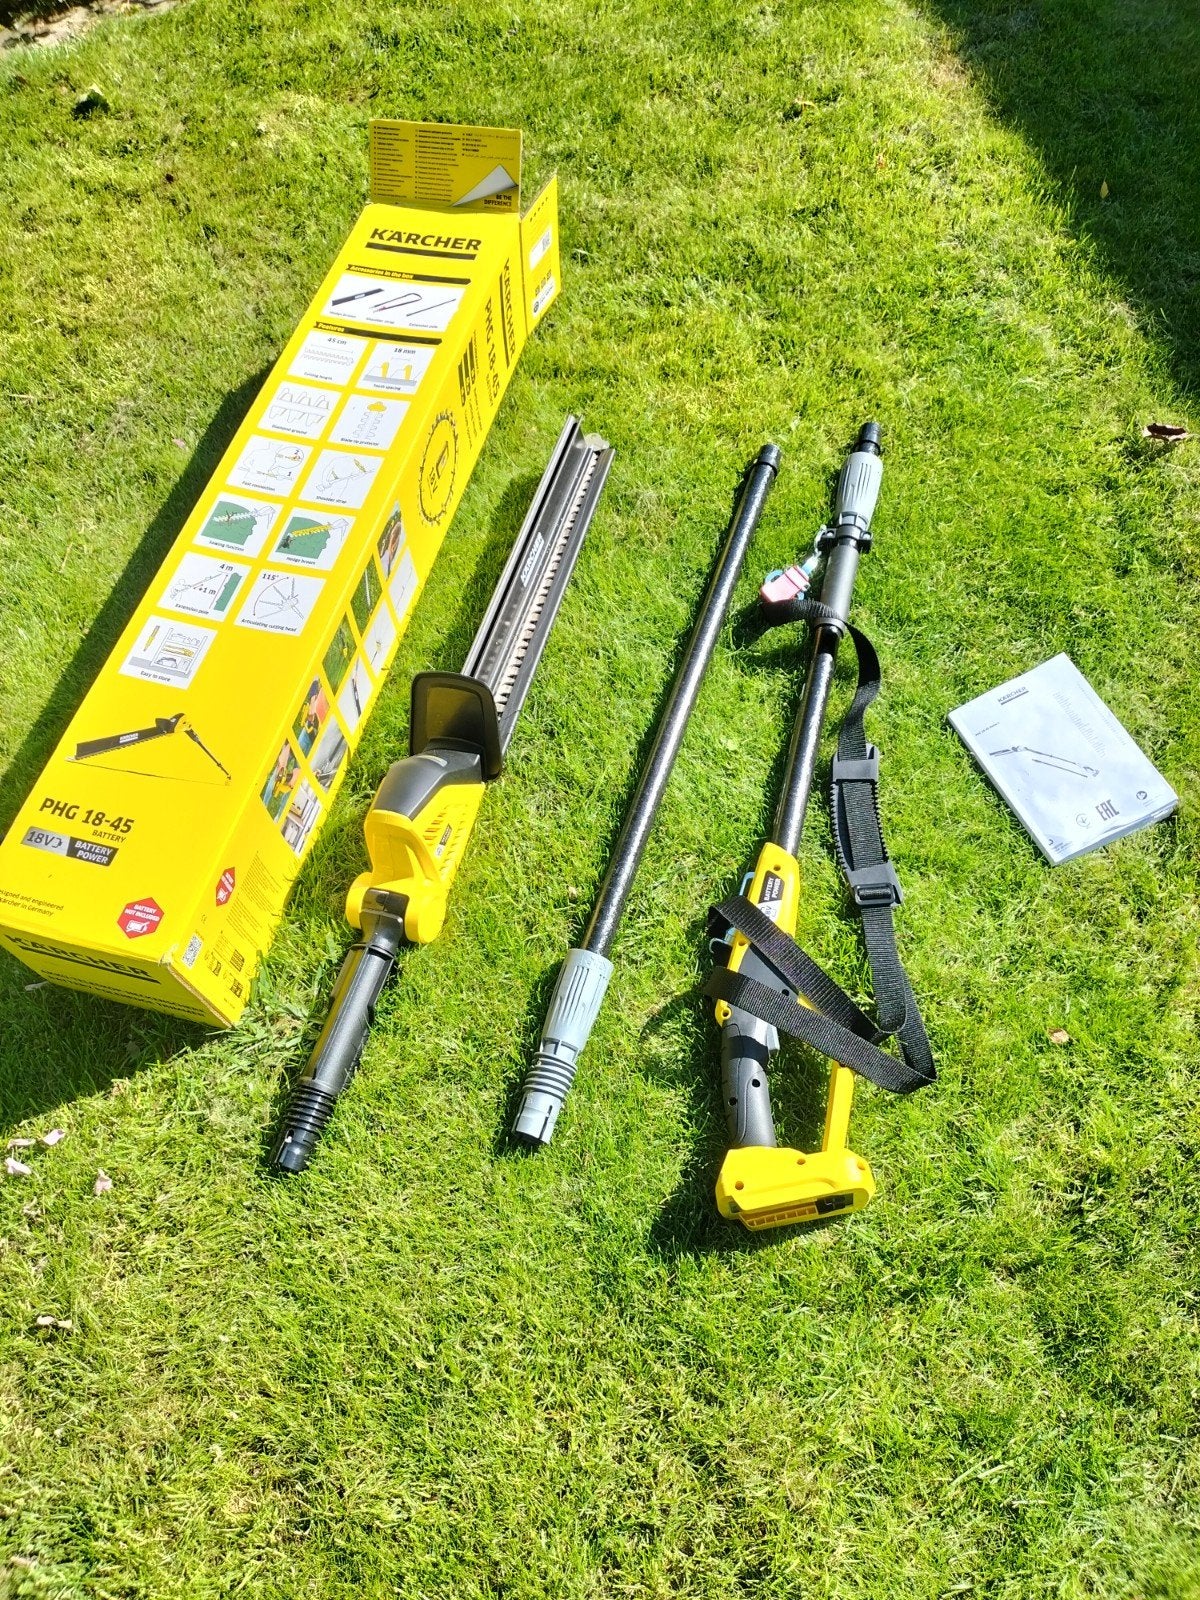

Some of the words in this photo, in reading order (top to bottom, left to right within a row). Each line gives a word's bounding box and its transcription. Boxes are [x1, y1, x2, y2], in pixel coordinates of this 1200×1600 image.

[369, 228, 482, 251] KÄRCHER
[349, 265, 384, 276] Accessories
[502, 257, 517, 356] KÄRCHER
[484, 296, 494, 341] PHG
[317, 323, 345, 333] Features
[487, 341, 501, 399] 18-45
[291, 428, 307, 436] ground
[225, 544, 245, 553] function
[219, 563, 225, 571] 4
[207, 588, 217, 596] m
[175, 603, 197, 614] Extension
[241, 618, 267, 628] Articulating
[267, 623, 284, 632] cutting
[140, 670, 152, 679] Easy
[158, 675, 171, 683] store
[997, 686, 1028, 704] KÄRCHER
[39, 798, 80, 820] PHG
[82, 809, 135, 834] 18-45
[26, 830, 56, 847] 18V
[92, 829, 127, 844] BATTERY
[75, 840, 113, 856] BATTERY
[76, 850, 109, 865] POWER
[771, 878, 781, 899] POWER
[20, 894, 32, 902] and
[32, 898, 64, 911] engineered
[134, 904, 157, 914] BATTERY
[27, 905, 54, 917] Germany
[124, 908, 137, 917] NOT
[135, 910, 160, 922] INCLUDED
[4, 934, 153, 978] KÄRCHER
